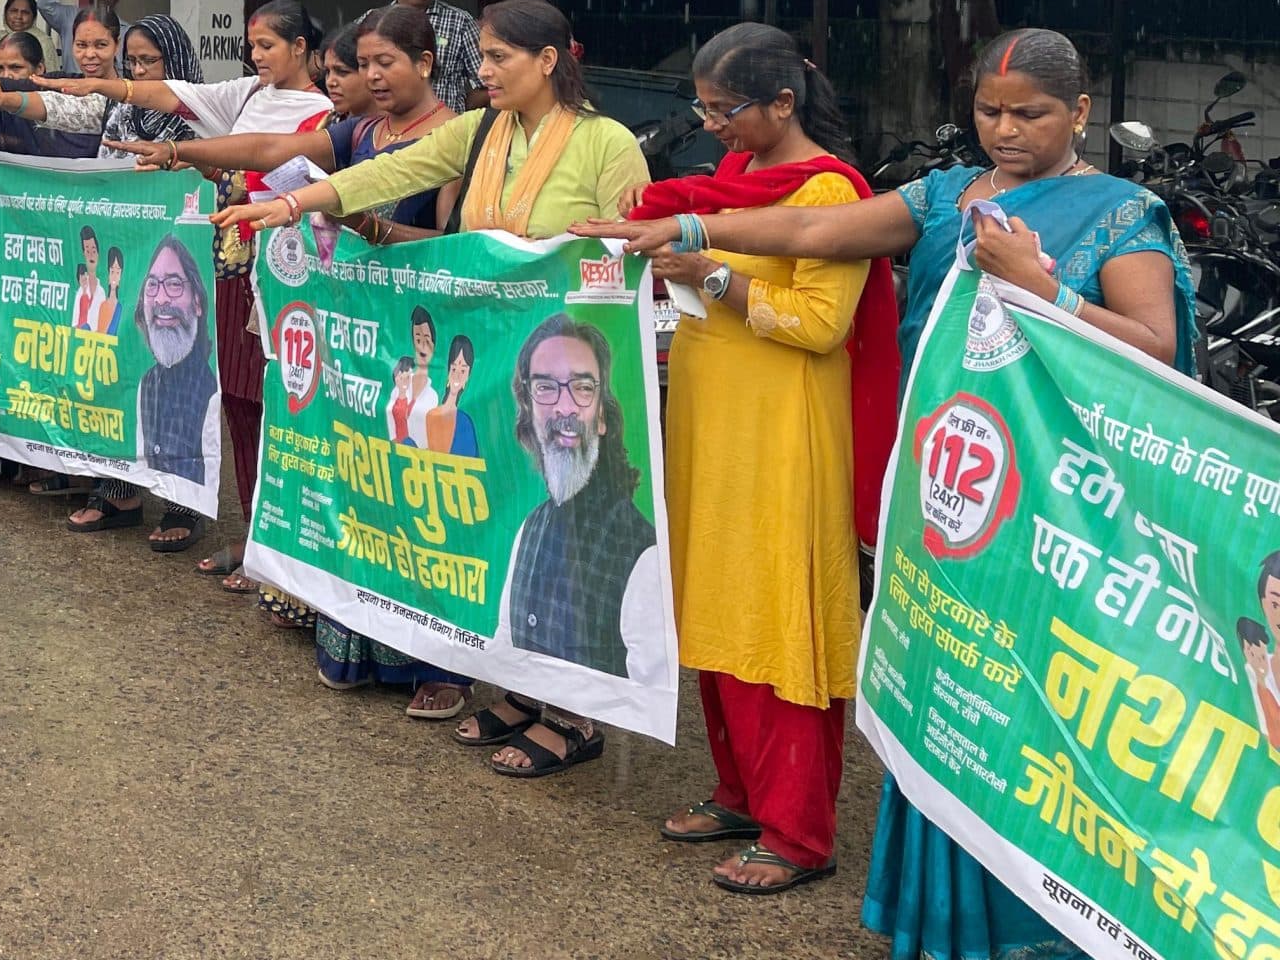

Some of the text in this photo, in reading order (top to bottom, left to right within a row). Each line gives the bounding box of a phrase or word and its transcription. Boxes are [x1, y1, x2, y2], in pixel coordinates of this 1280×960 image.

[200, 35, 244, 61] PARKING
[211, 13, 232, 29] NO
[3, 233, 64, 267] हम सब का
[368, 260, 389, 286] लिए
[1, 269, 70, 311] एक ही नारा
[13, 319, 119, 400] नशा मुक्त
[284, 328, 314, 369] 112
[353, 318, 379, 358] का
[74, 402, 125, 442] हमारा
[344, 374, 382, 418] नारा
[321, 438, 330, 456] के
[929, 426, 995, 505] 112
[1103, 416, 1130, 452] पर
[1130, 423, 1173, 466] रोक
[1170, 437, 1197, 476] के
[1194, 447, 1242, 495] लिए
[333, 420, 395, 506] नशा
[396, 443, 489, 544] मुक्त
[337, 507, 392, 571] जीवन
[390, 526, 415, 582] हो
[413, 545, 488, 604] हमारा
[1032, 513, 1103, 590] एक
[1095, 553, 1161, 627] ही
[357, 589, 379, 606] सूचना
[454, 628, 486, 651] गिरिडीह
[895, 545, 917, 584] नशा
[918, 569, 930, 596] से
[928, 583, 991, 637] छुटकारे
[993, 619, 1018, 650] के
[889, 573, 910, 611] लिए
[910, 599, 935, 638] तुरंत
[935, 623, 982, 669] संपर्क
[982, 656, 1024, 693] करें
[1045, 616, 1260, 822] नशा
[1014, 744, 1148, 887] जीवन
[1151, 848, 1218, 933] हो
[1042, 873, 1096, 921] सूचना
[1096, 911, 1122, 941] एवं
